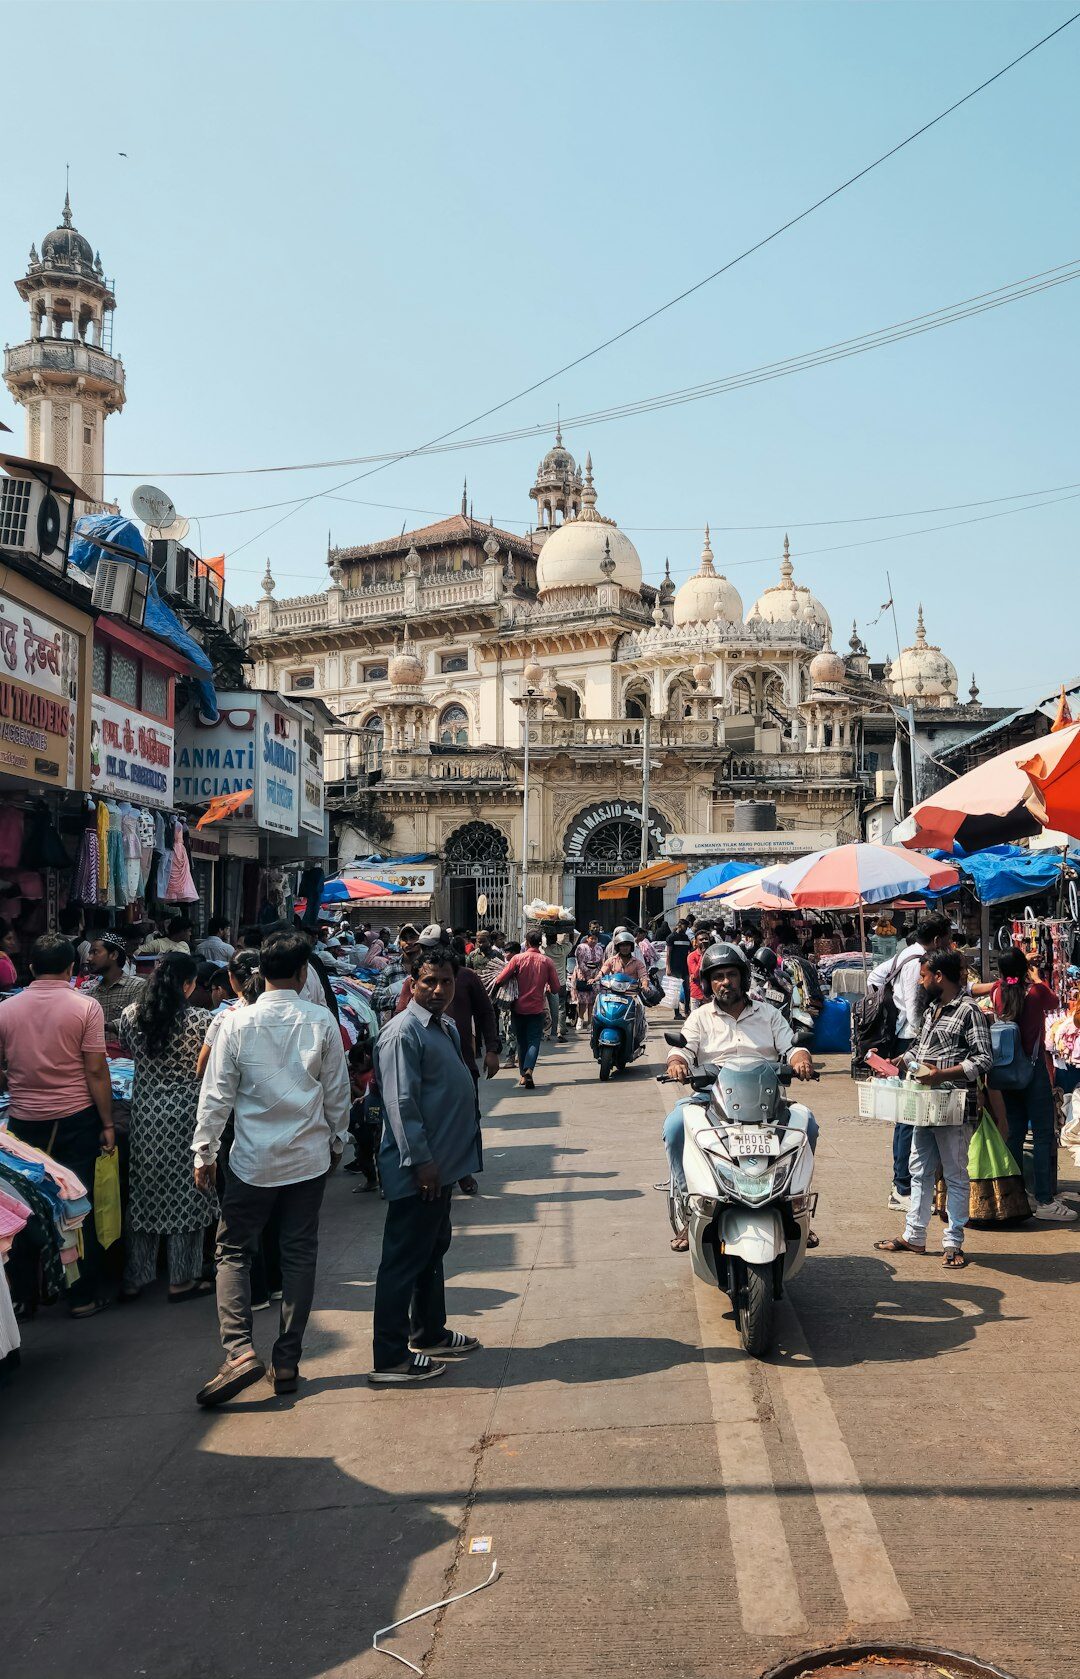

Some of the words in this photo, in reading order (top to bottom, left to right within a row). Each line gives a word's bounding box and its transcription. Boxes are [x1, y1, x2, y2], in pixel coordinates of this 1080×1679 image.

[0, 682, 12, 717] U
[13, 685, 69, 737] TRADERS
[173, 777, 254, 797] PTICIANS
[568, 826, 590, 857] JUMA
[583, 804, 622, 830] MASJID
[739, 1145, 771, 1154] C8760
